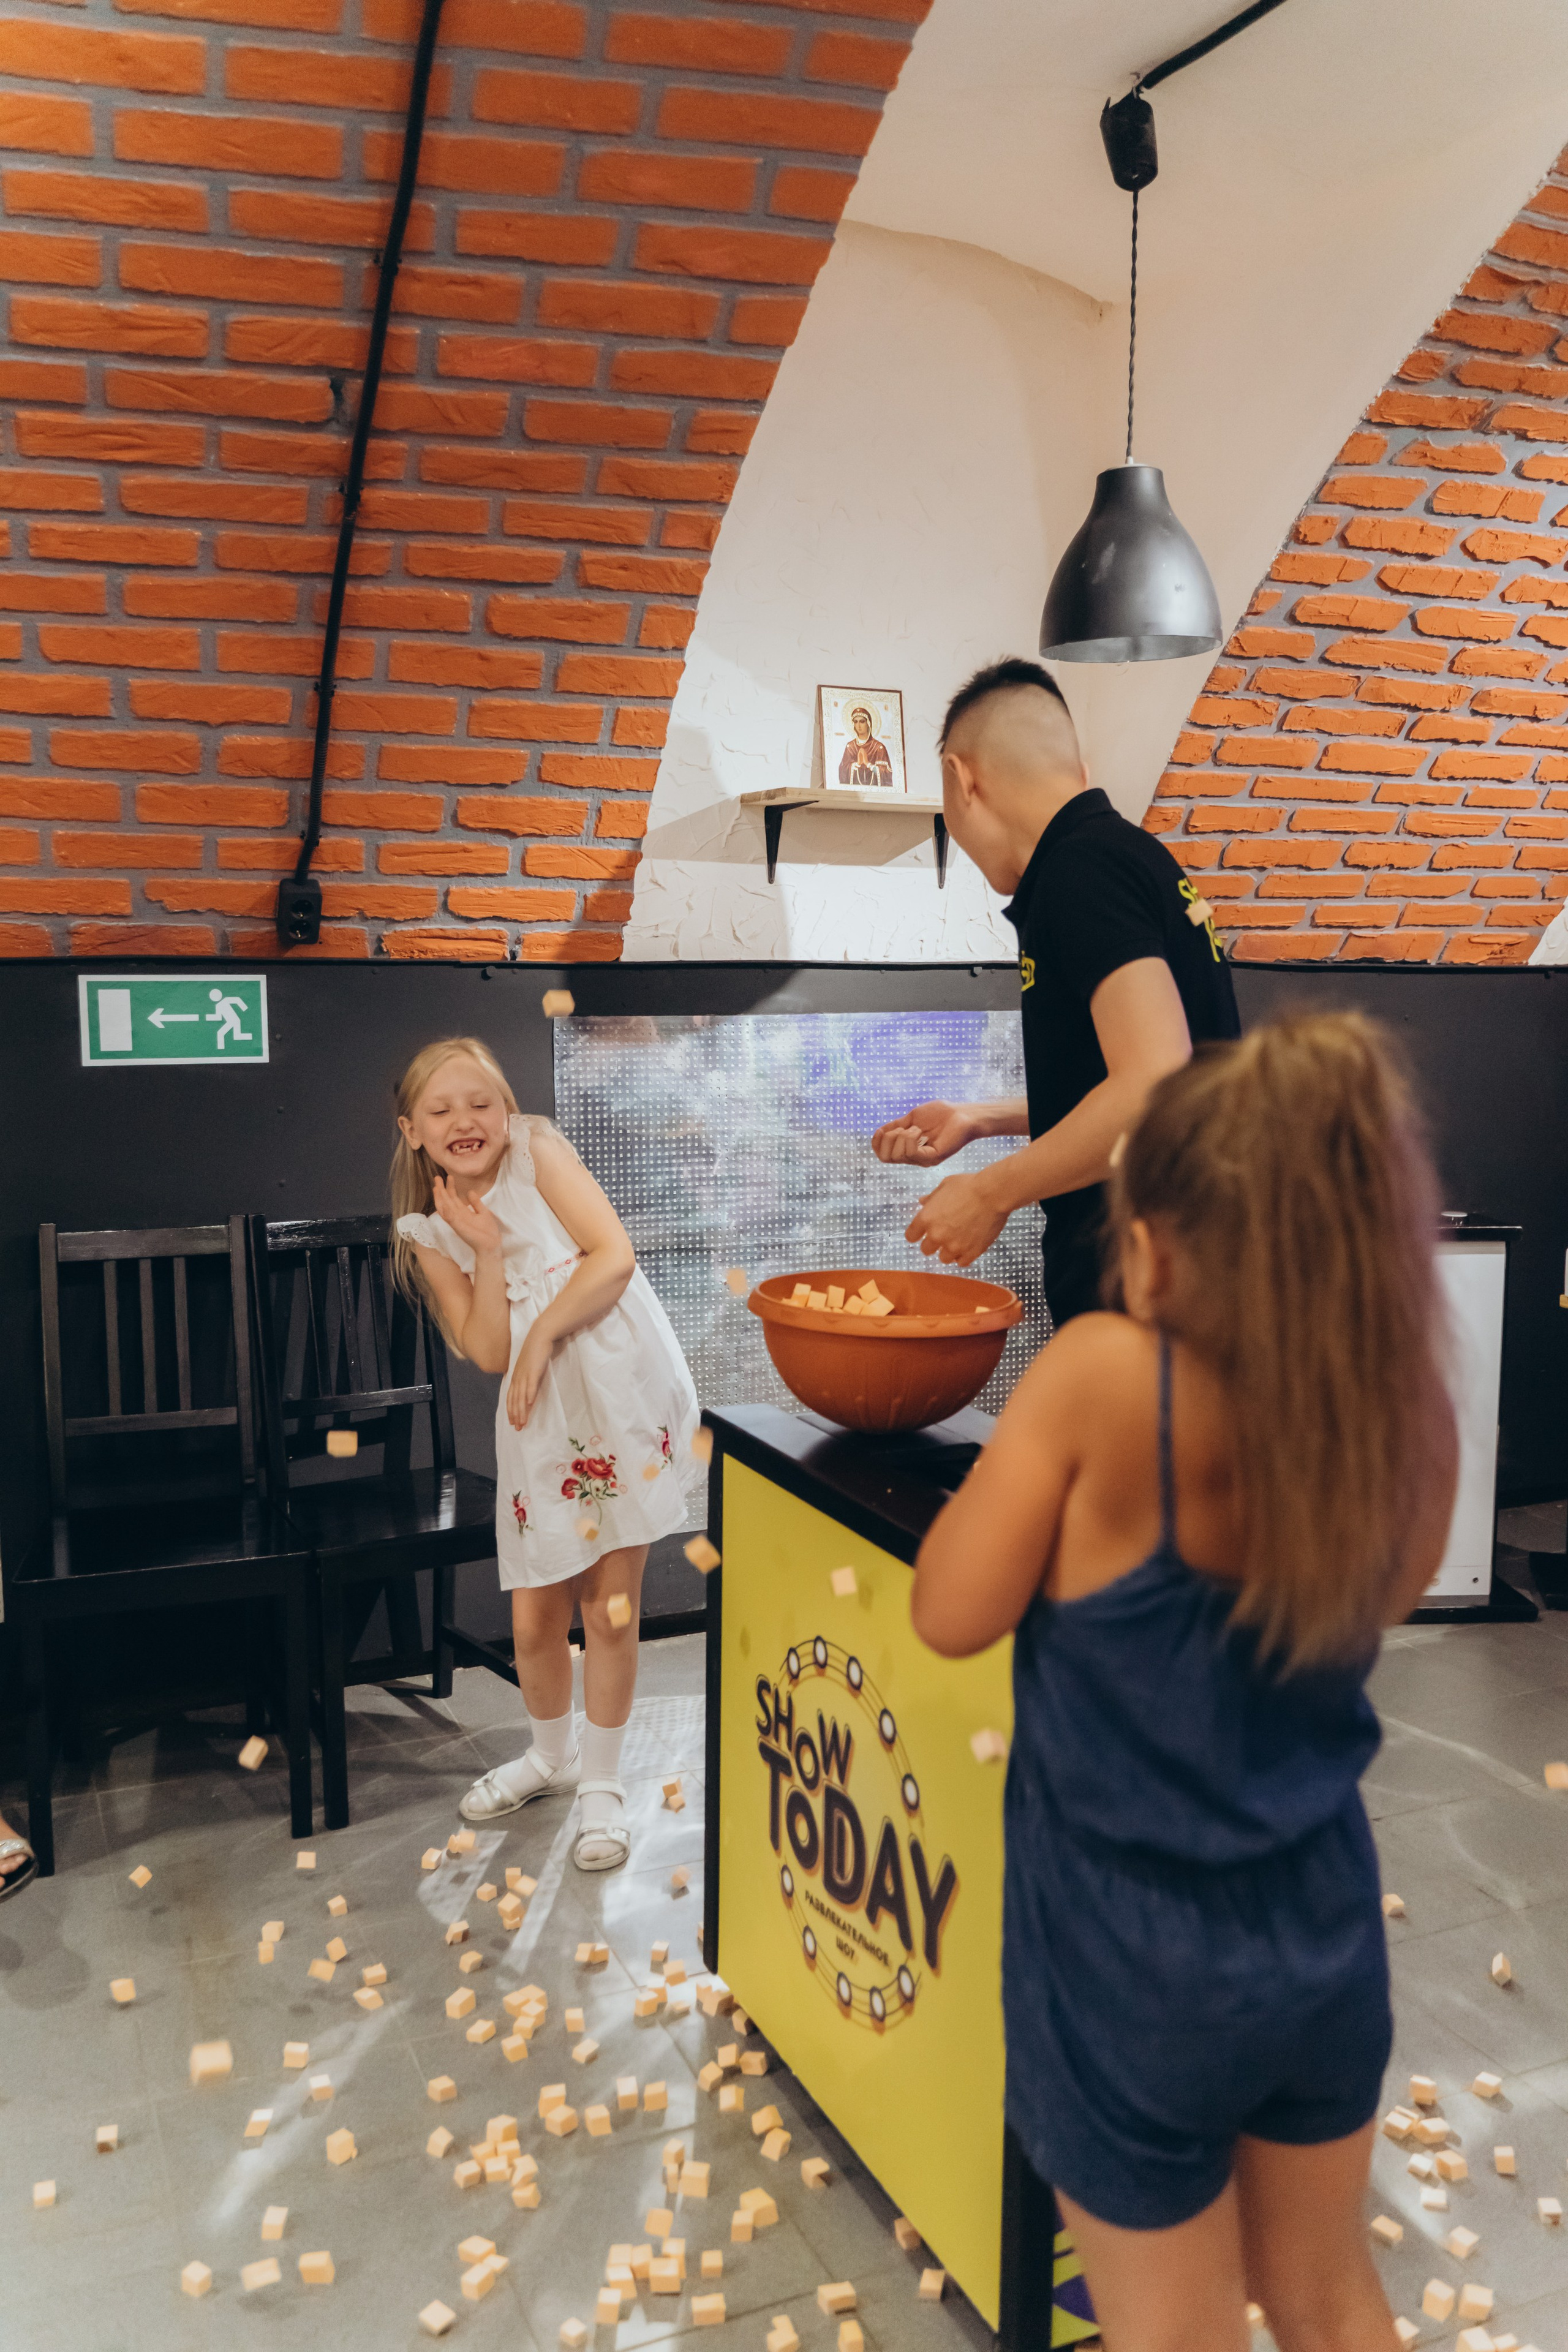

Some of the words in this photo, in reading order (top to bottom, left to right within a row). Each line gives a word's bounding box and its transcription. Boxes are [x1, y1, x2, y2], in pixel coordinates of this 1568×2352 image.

[756, 1674, 853, 1791] SHOW
[758, 1736, 957, 1969] TODAY
[805, 1890, 889, 1966] РАЗВЛЕКАТЕЛЬНОЕ
[836, 1936, 855, 1960] ШОУ
